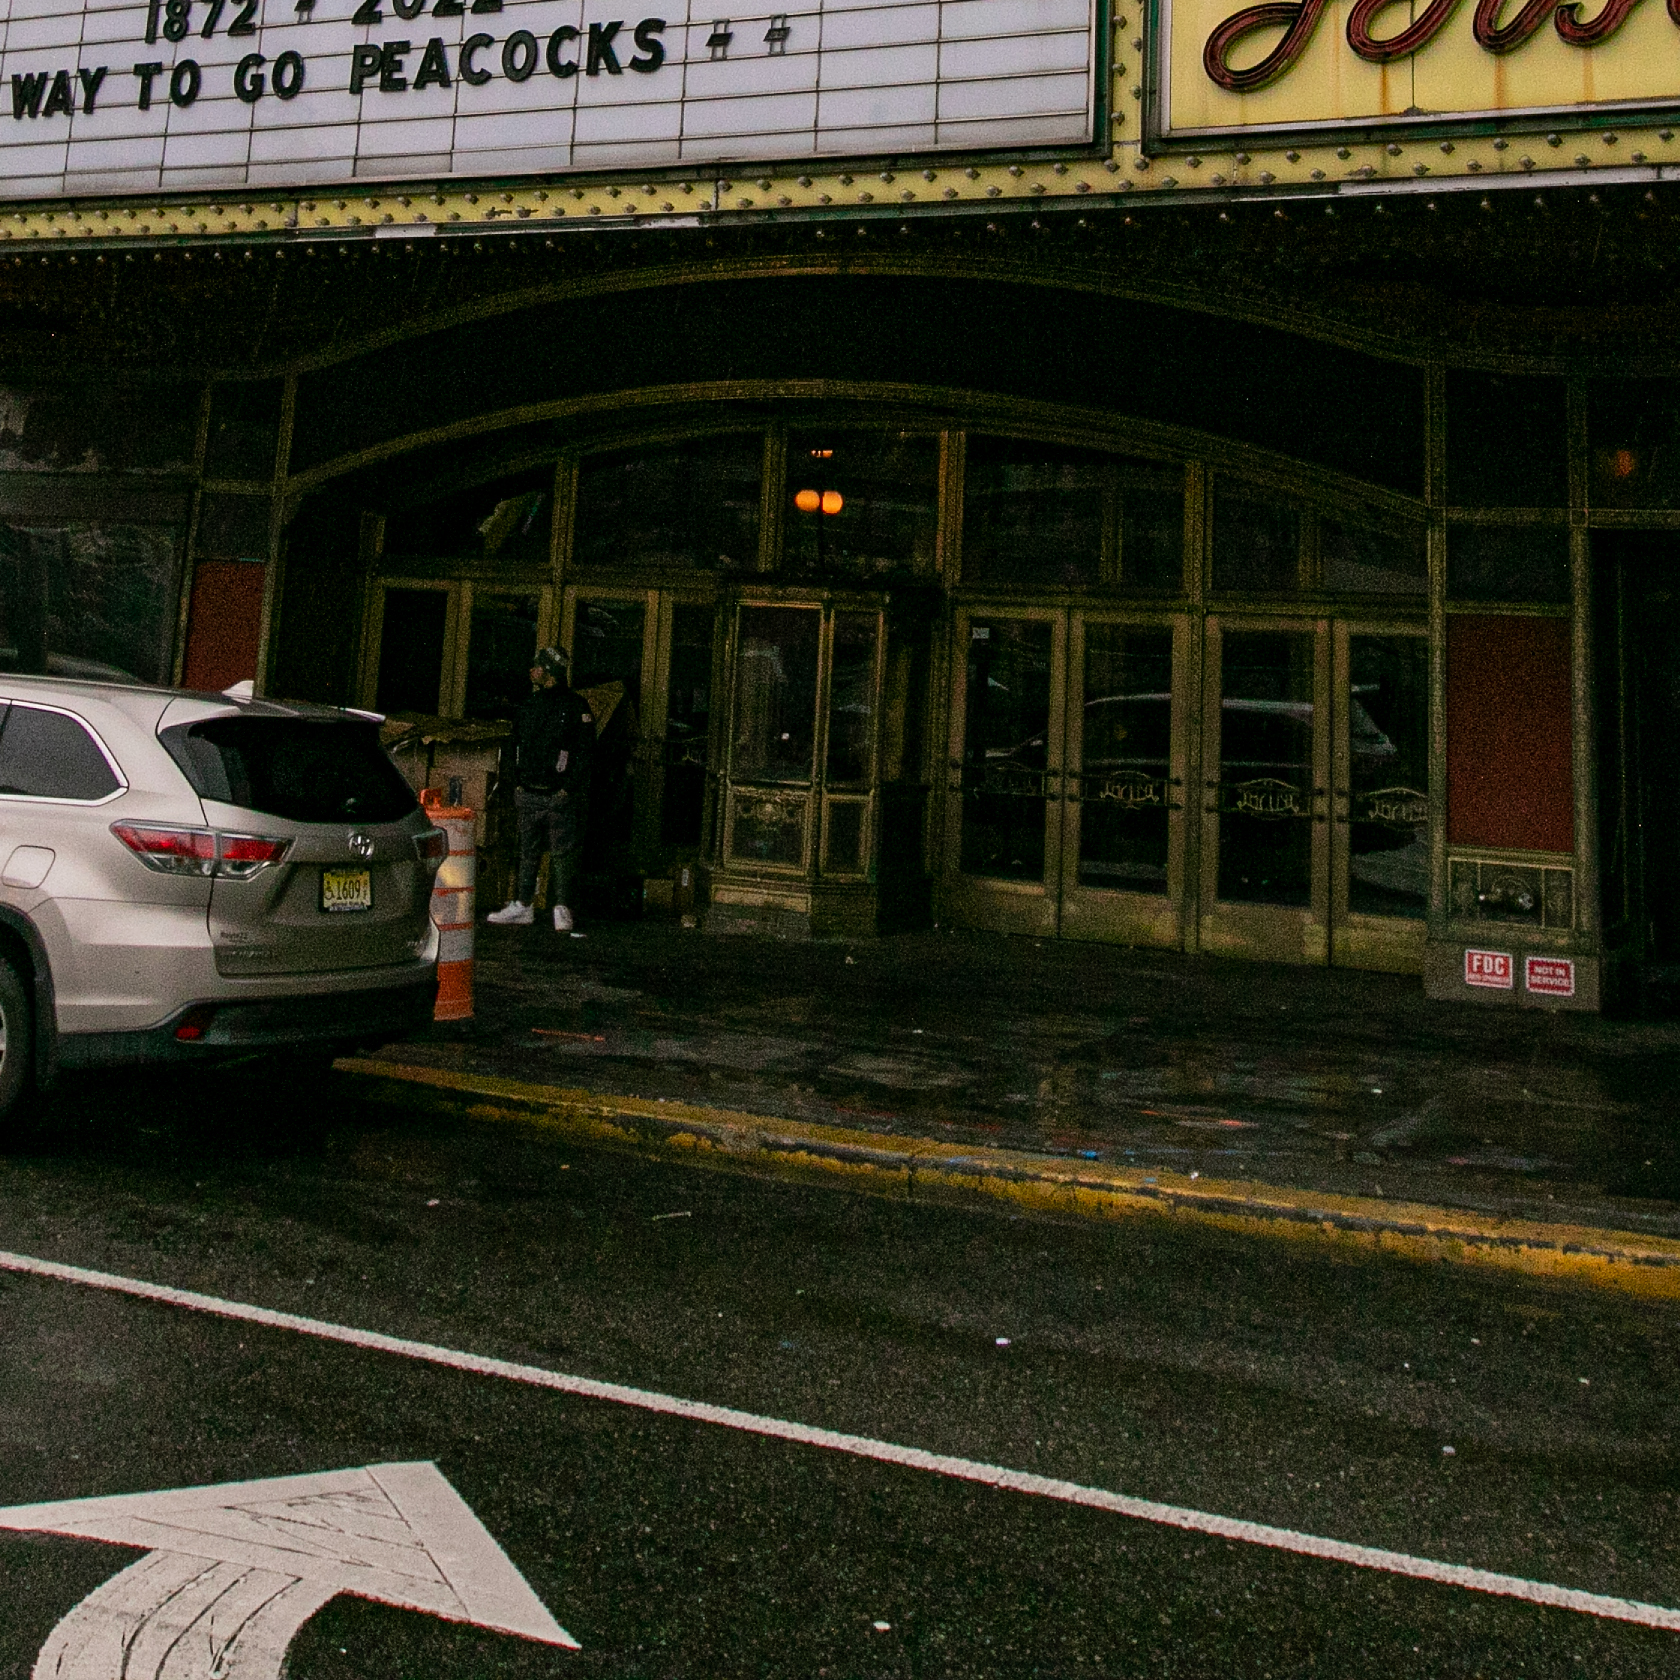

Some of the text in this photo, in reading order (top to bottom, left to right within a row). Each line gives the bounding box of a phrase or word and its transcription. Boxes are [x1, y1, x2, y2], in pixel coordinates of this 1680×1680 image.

[11, 65, 108, 120] WAY
[133, 59, 201, 111] TO
[233, 50, 305, 104] GO
[348, 17, 666, 95] PEACOCKS
[1472, 954, 1505, 976] FDC
[1534, 966, 1553, 976] NOT
